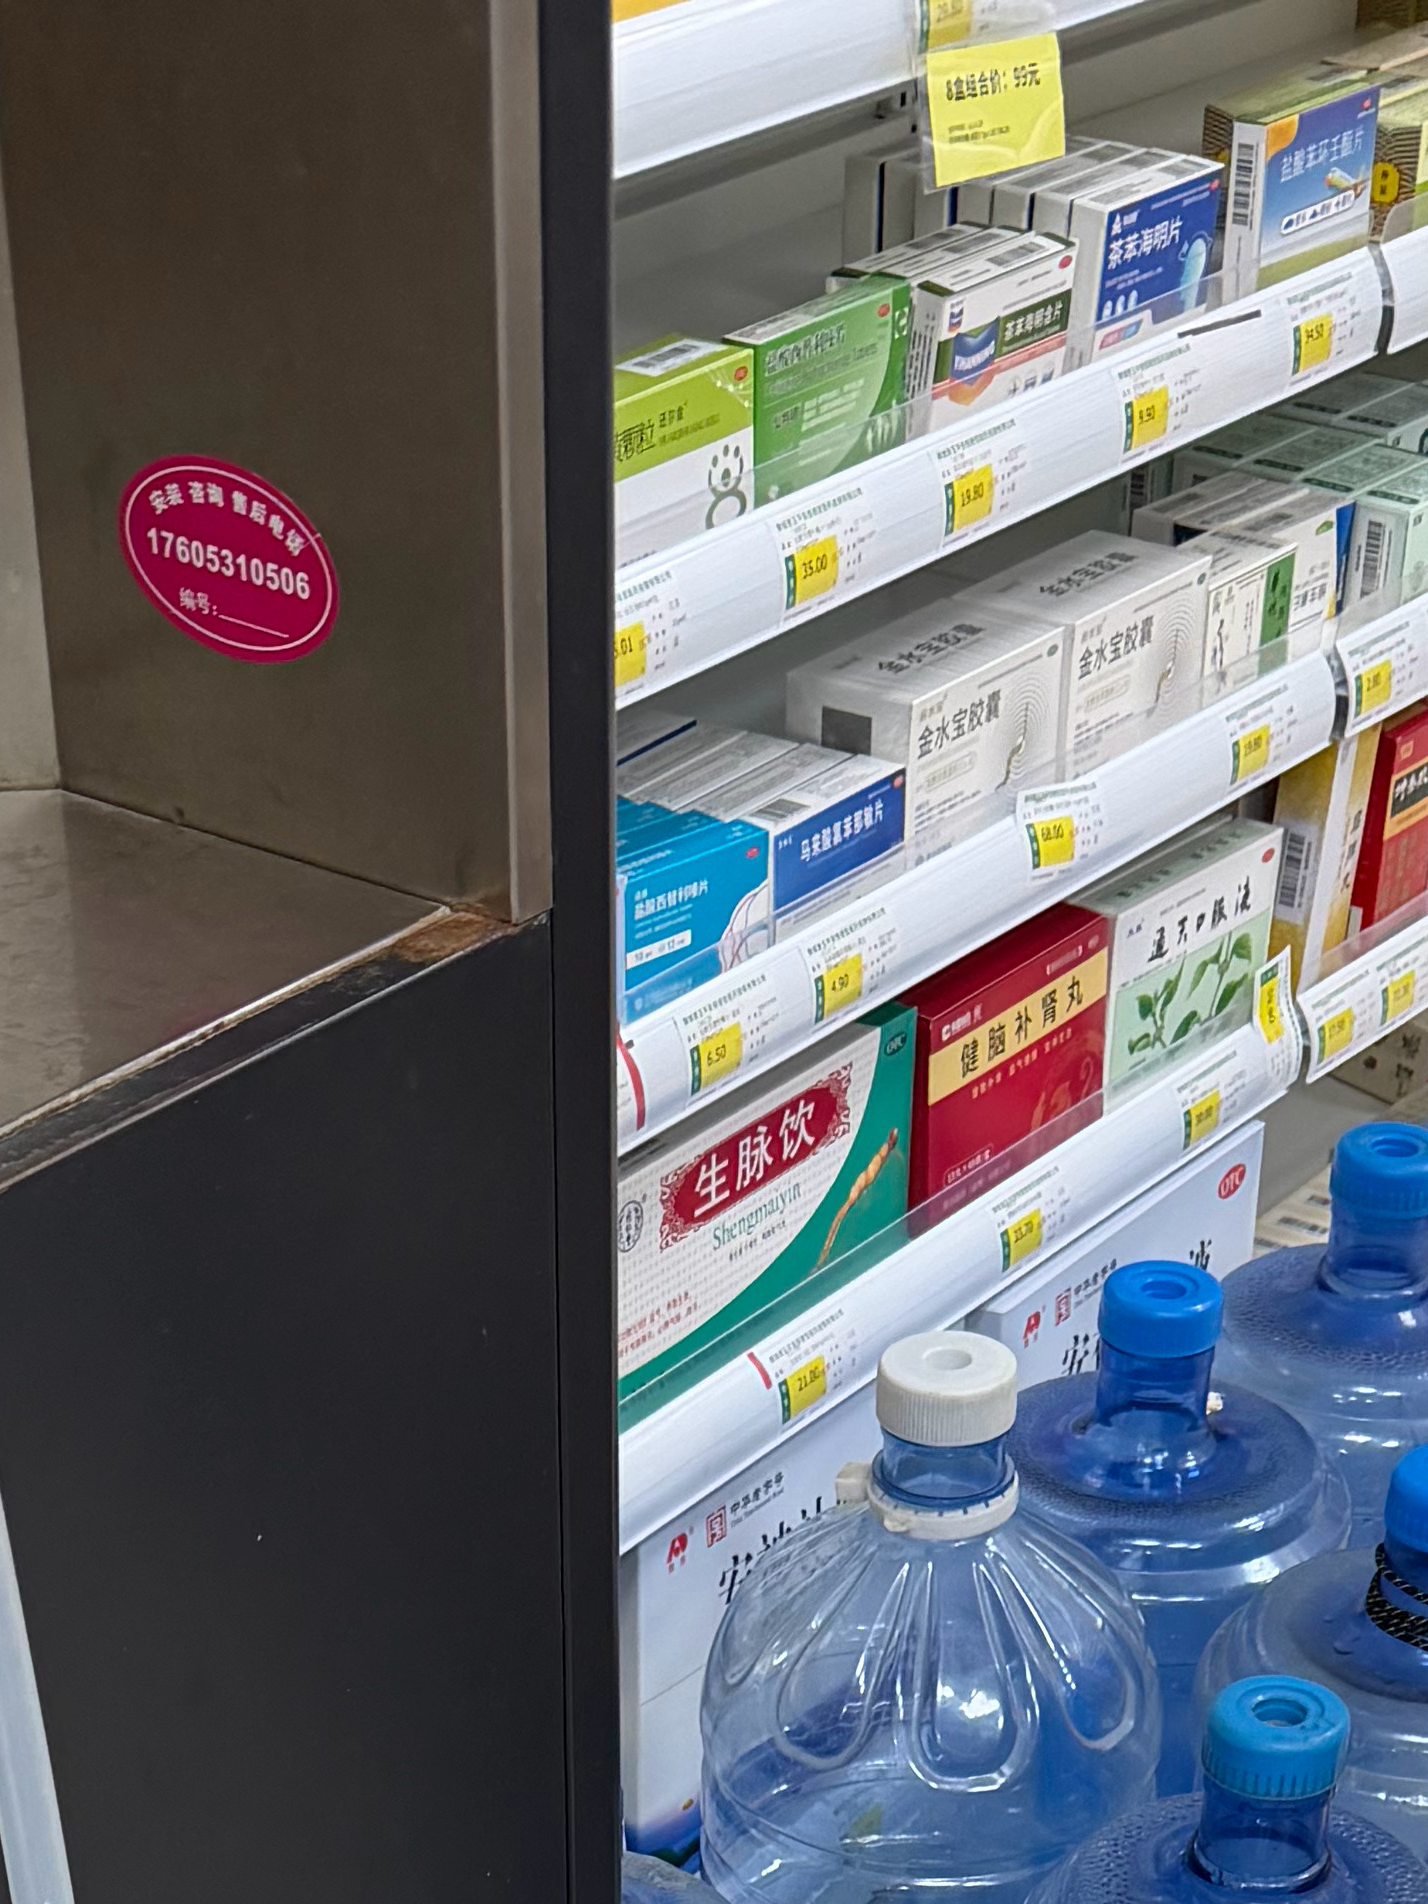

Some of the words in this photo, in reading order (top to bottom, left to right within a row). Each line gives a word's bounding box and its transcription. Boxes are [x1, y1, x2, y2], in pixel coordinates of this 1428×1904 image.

[1107, 214, 1184, 271] 茶苯海明片
[148, 482, 184, 515] 安装
[187, 480, 225, 508] 咨询
[147, 527, 311, 600] 17605310506
[1077, 615, 1155, 681] 金水宝胶囊
[917, 689, 1002, 760] 金水宝胶囊
[800, 798, 885, 863] 马来酸氯苯那敏片
[1147, 875, 1252, 963] 通天口服液
[830, 974, 850, 994] 4.90
[706, 1044, 727, 1066] 6.50
[960, 975, 1084, 1080] 健脑补肾丸
[693, 1099, 816, 1219] 生脉饮
[1219, 1165, 1246, 1198] OTC
[729, 1471, 784, 1515] 中华老字号
